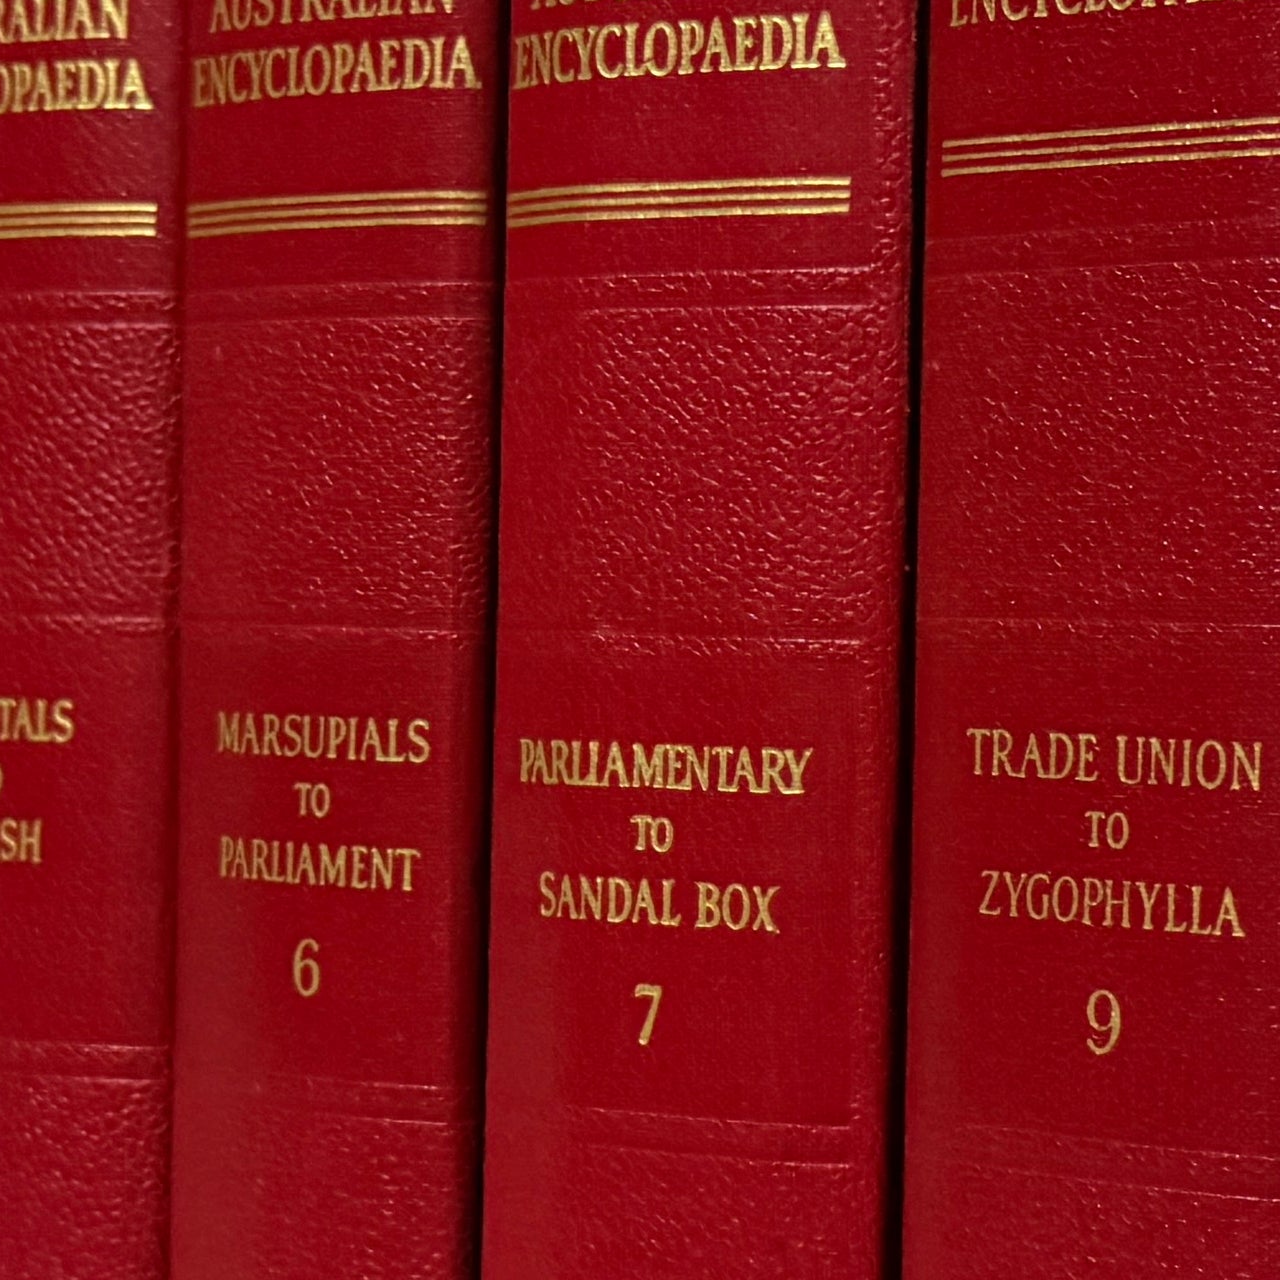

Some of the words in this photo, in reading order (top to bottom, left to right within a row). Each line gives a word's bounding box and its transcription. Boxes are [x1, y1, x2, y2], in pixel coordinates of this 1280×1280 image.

[191, 34, 484, 110] ENCYCLOPAEDIA
[513, 11, 848, 91] ENCYCLOPAEDIA
[216, 710, 433, 766] MARSUPIALS
[519, 737, 815, 798] PARLIAMENTARY
[966, 727, 1100, 784] TRADE
[1115, 733, 1264, 793] UNION
[293, 780, 334, 821] TO
[1084, 809, 1132, 852] TO
[218, 834, 423, 895] PARLIAMENT
[629, 813, 676, 856] TO
[538, 870, 684, 929] SANDAL
[695, 881, 780, 936] BOX
[978, 869, 1248, 941] ZYGOPHYLLA
[291, 937, 323, 999] 6
[633, 982, 665, 1048] 7
[1085, 988, 1124, 1058] 9
